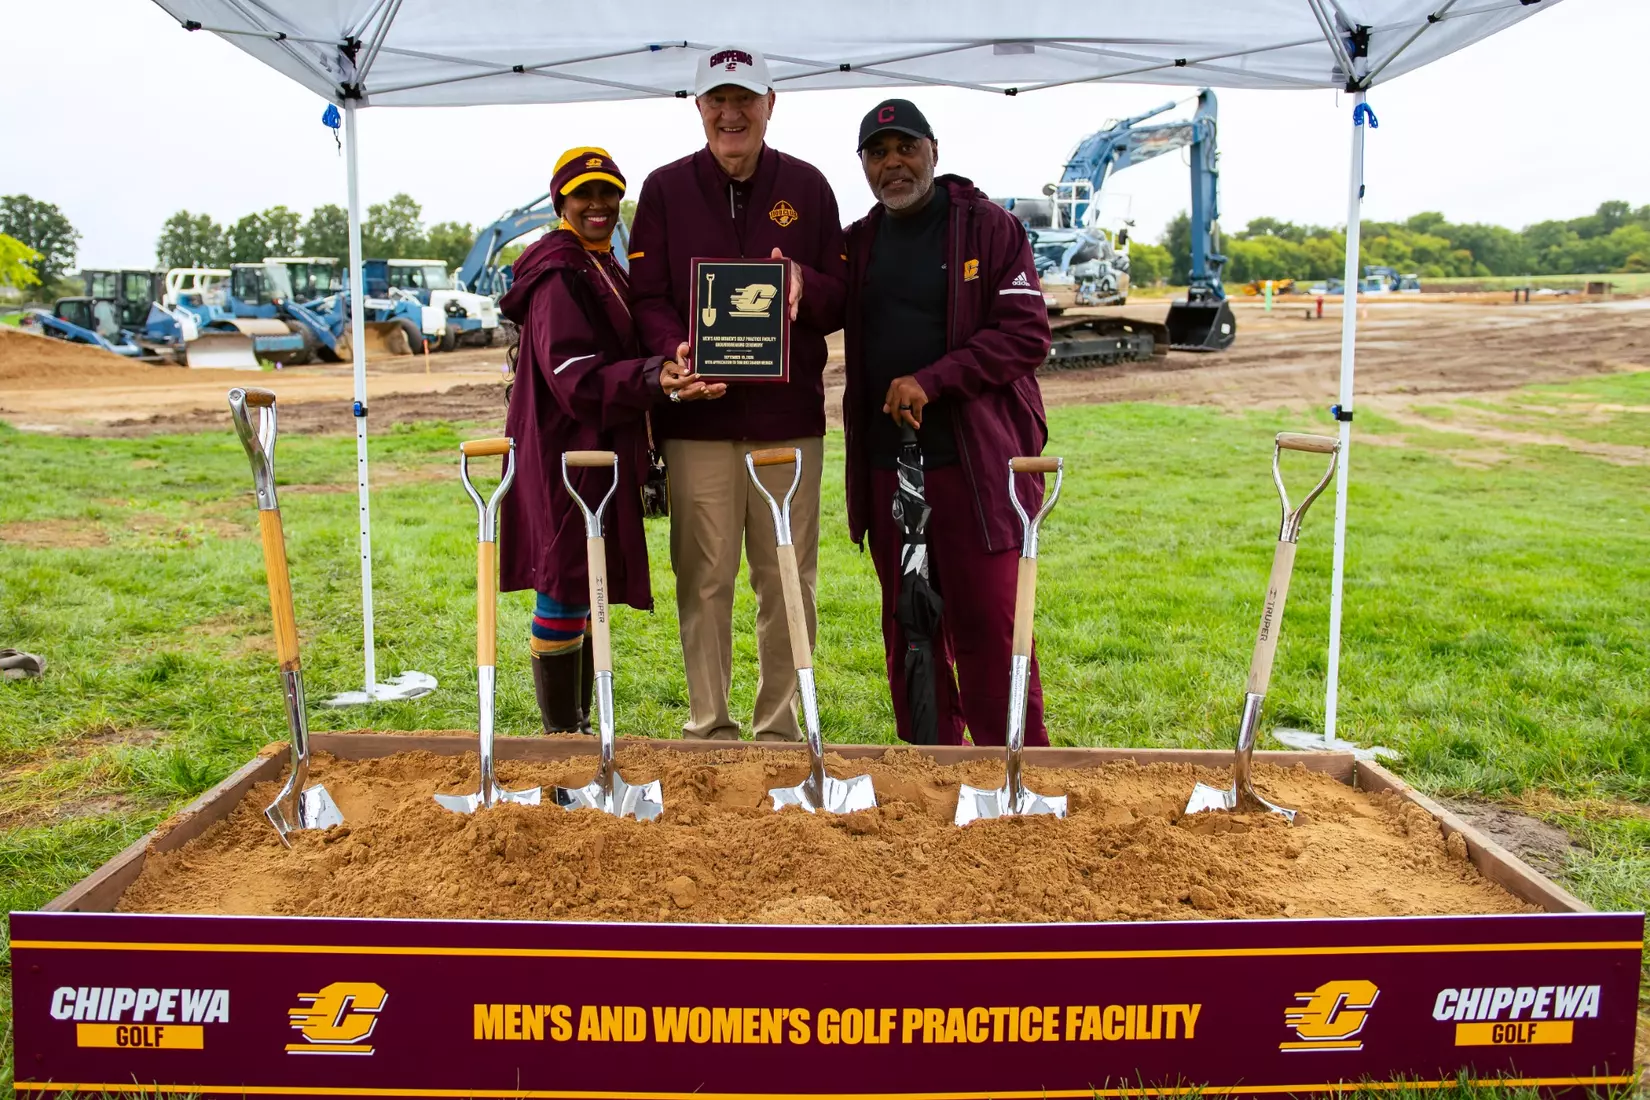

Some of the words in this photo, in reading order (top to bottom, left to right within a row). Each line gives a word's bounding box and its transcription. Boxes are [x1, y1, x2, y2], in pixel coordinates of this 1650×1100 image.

[709, 49, 753, 68] CHIPPEWAS
[878, 105, 895, 124] C
[596, 587, 605, 624] TRUPER
[1260, 601, 1276, 641] TRUPER
[50, 986, 229, 1023] CHIPPEWA
[1432, 985, 1601, 1021] CHIPPEWA
[116, 1025, 164, 1047] GOLF
[474, 1003, 572, 1042] MEN'S
[577, 1005, 647, 1042] AND
[652, 1006, 811, 1045] WOMEN'S
[817, 1007, 897, 1045] GOLF
[902, 1006, 1059, 1044] PRACTICE
[1065, 1004, 1202, 1041] FACILITY
[1491, 1022, 1538, 1044] GOLF
